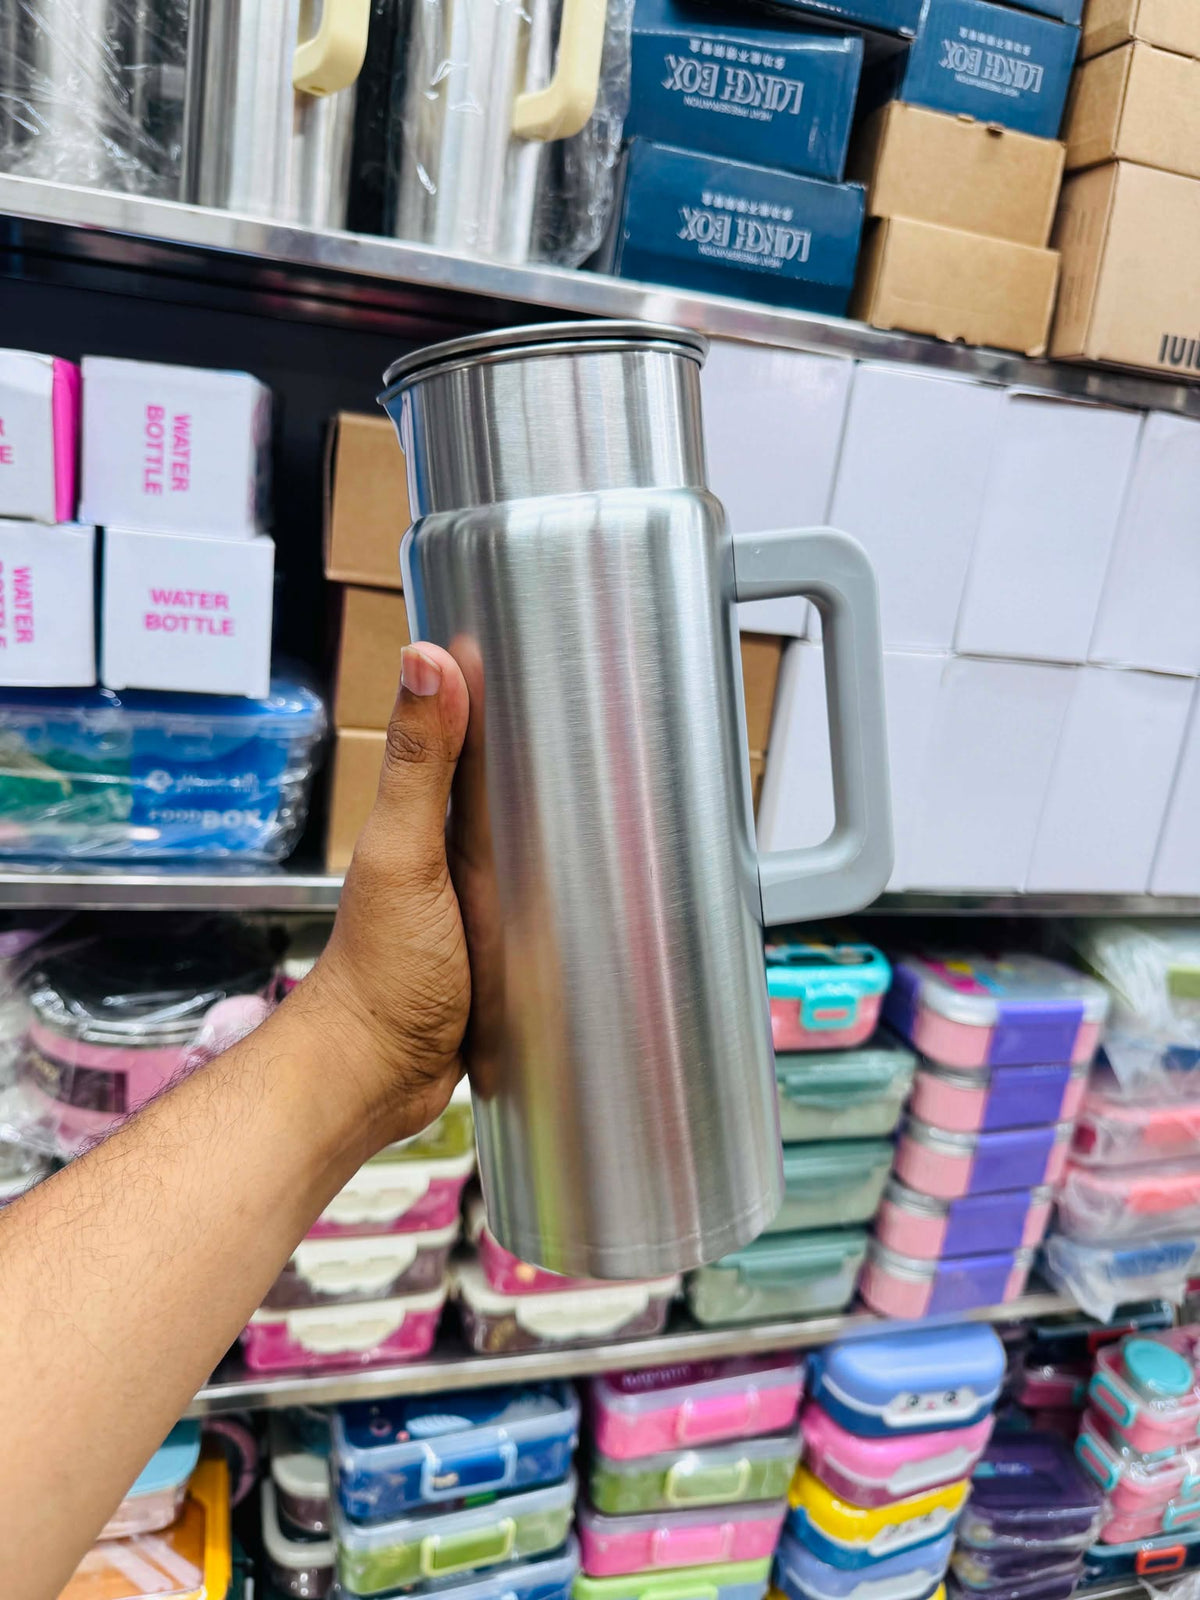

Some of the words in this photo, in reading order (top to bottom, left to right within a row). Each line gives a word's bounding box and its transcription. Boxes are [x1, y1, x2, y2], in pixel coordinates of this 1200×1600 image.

[661, 53, 720, 98] BOX
[938, 39, 982, 76] BOX
[981, 51, 1044, 93] LUNCH
[719, 66, 805, 115] LUNCH
[676, 205, 732, 247] BOX
[732, 218, 812, 263] LUNCH
[143, 405, 165, 496] BOTTLE
[171, 414, 191, 492] WATER
[12, 567, 34, 643] WATER
[150, 589, 229, 610] WATER
[144, 613, 235, 636] BOTTLE
